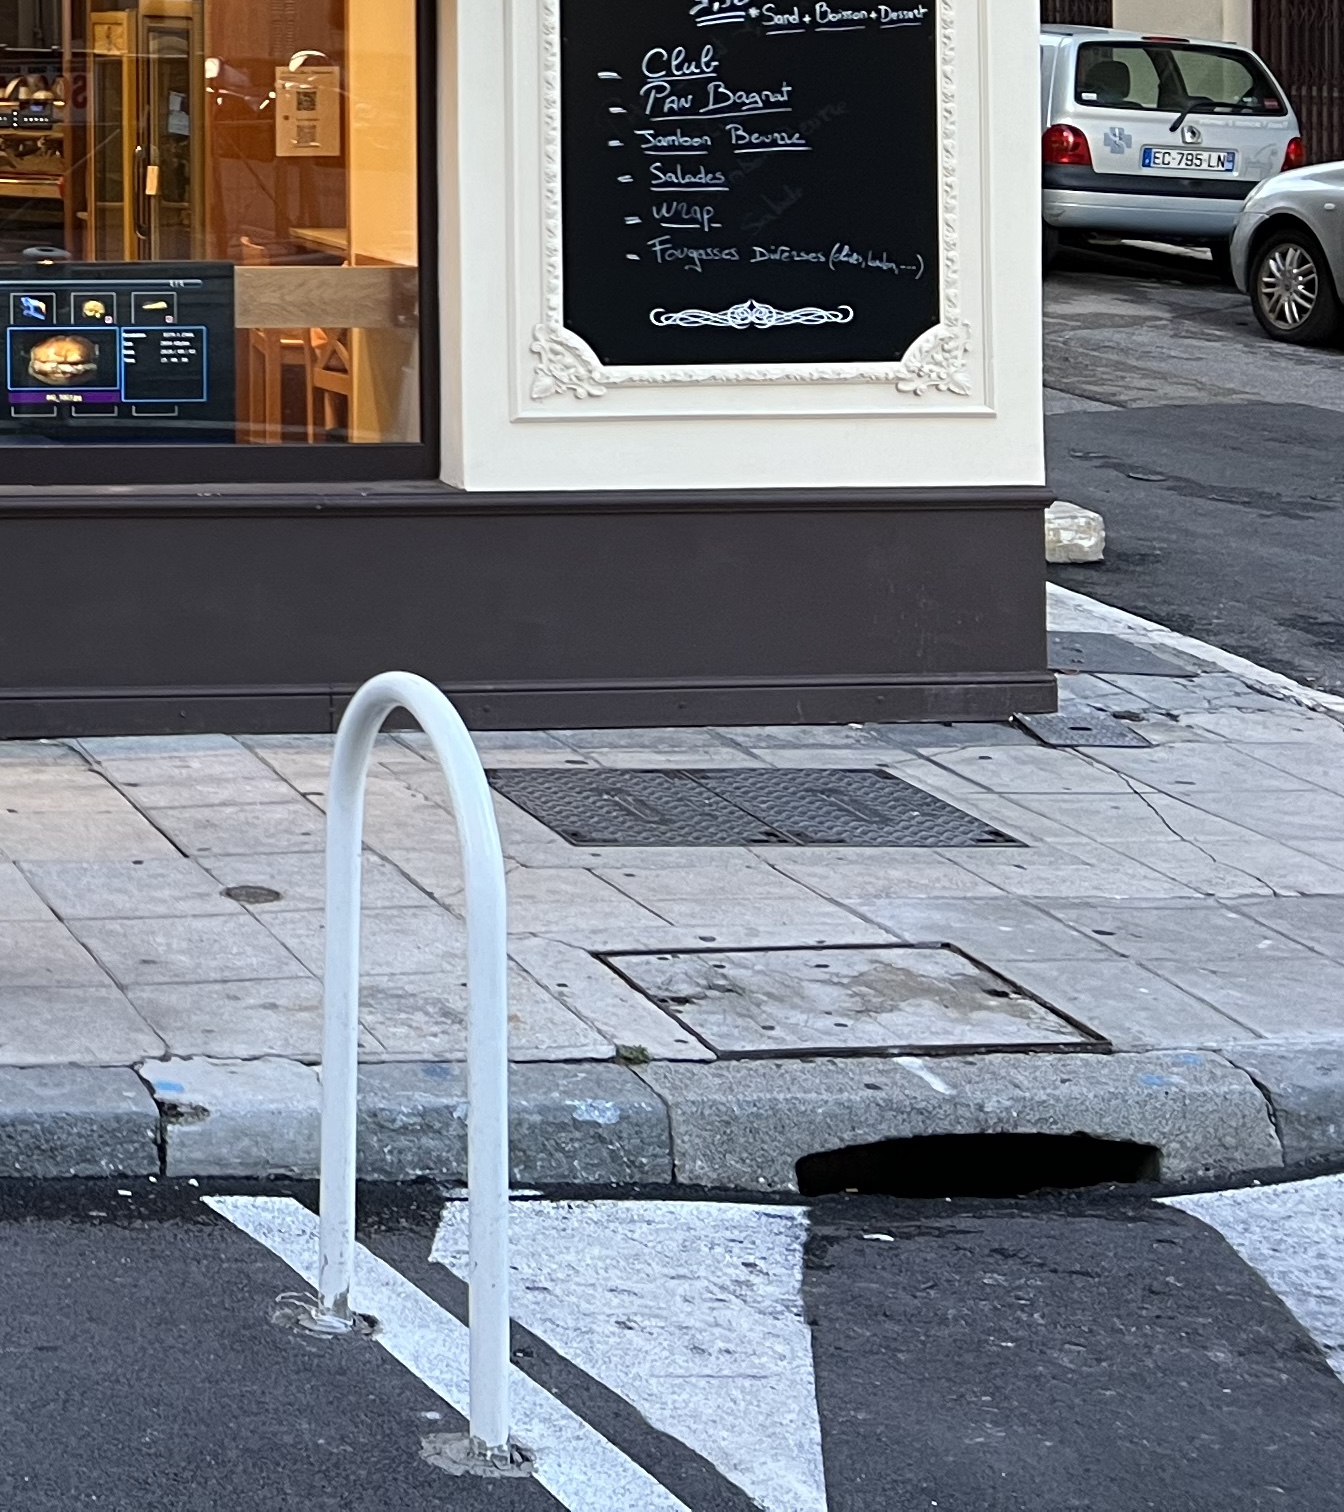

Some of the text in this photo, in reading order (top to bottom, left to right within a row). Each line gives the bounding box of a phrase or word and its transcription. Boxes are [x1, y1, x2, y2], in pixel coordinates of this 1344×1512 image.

[815, 1, 868, 23] Boisson
[878, 4, 929, 21] Dessert
[641, 44, 720, 78] Club
[699, 81, 793, 113] Bagnat
[633, 123, 806, 148] Jambon Beurre
[649, 162, 726, 185] Salades
[647, 235, 740, 272] Fougasses
